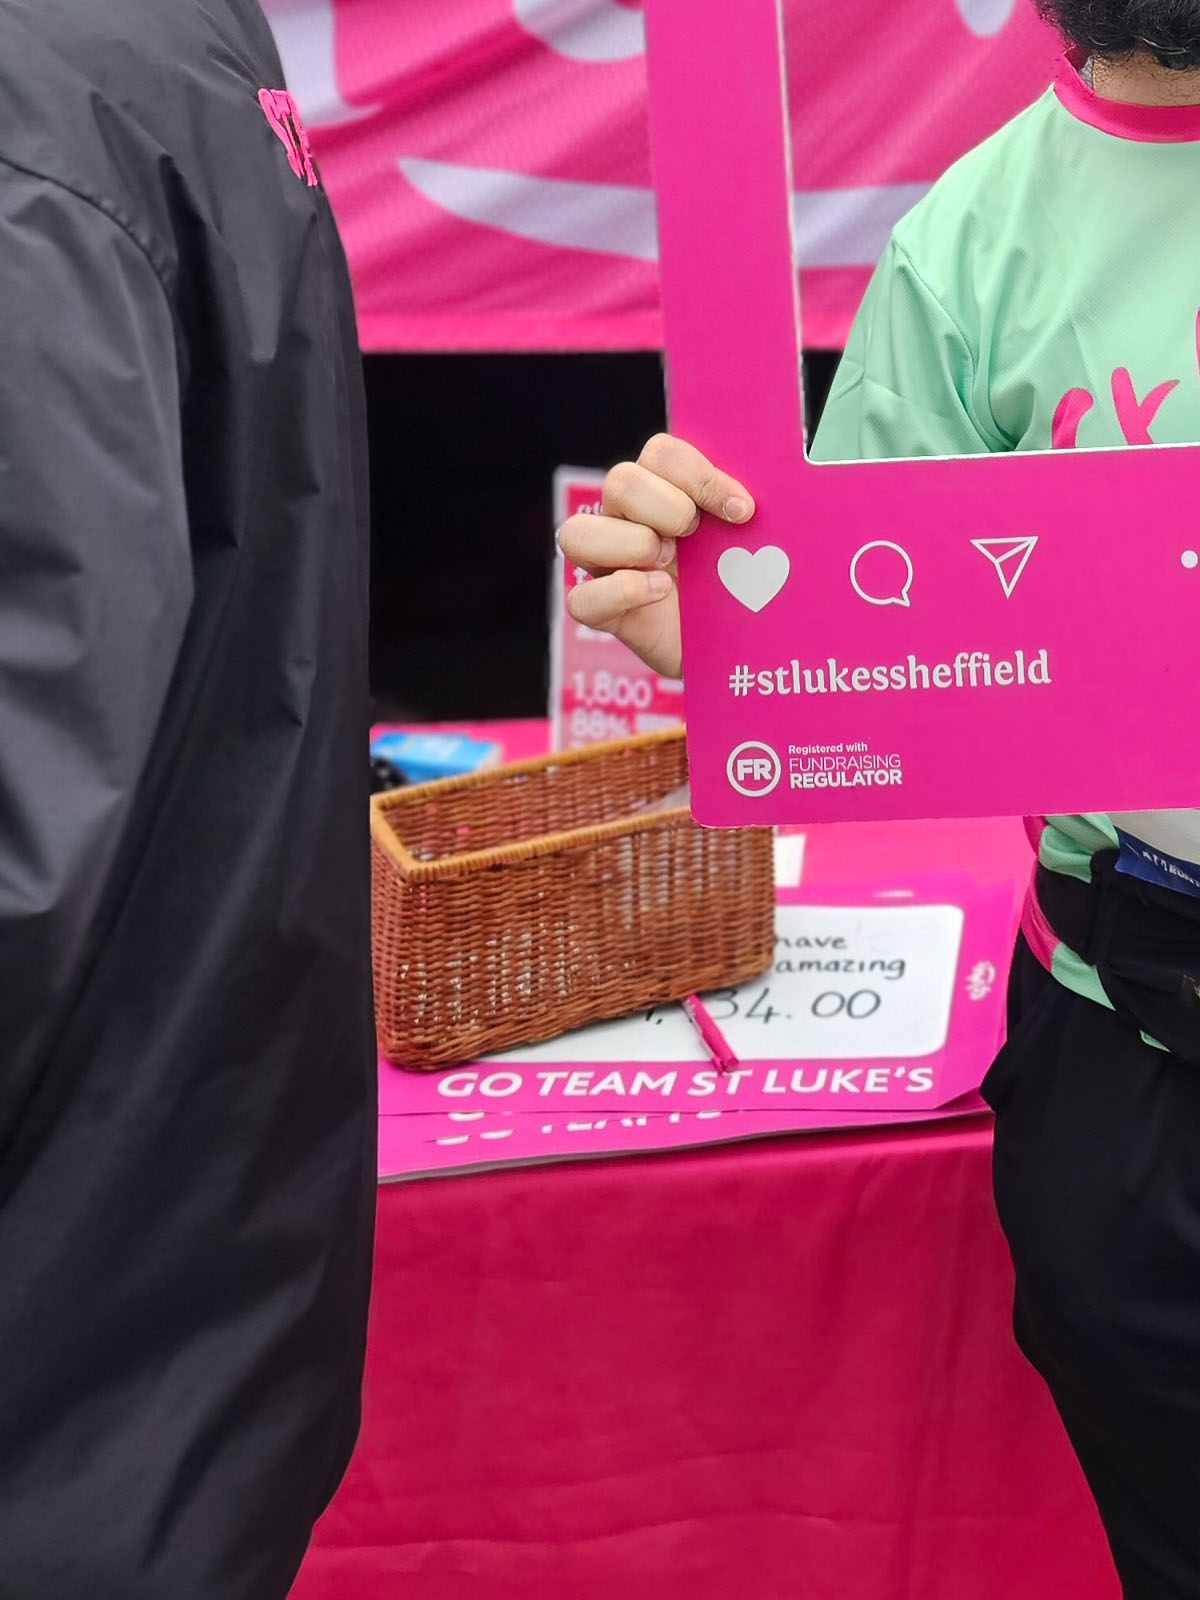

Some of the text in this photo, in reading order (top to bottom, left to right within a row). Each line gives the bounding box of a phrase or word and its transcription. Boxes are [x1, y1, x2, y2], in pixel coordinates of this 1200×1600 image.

[728, 649, 1052, 697] #stlukessheffield
[788, 741, 868, 756] Registered with
[737, 759, 773, 781] FR
[789, 753, 901, 773] FUNDRAISING
[790, 769, 903, 789] REGULATOR
[775, 957, 907, 980] amazing
[437, 1066, 935, 1098] GO TEAM ST LUKE'S
